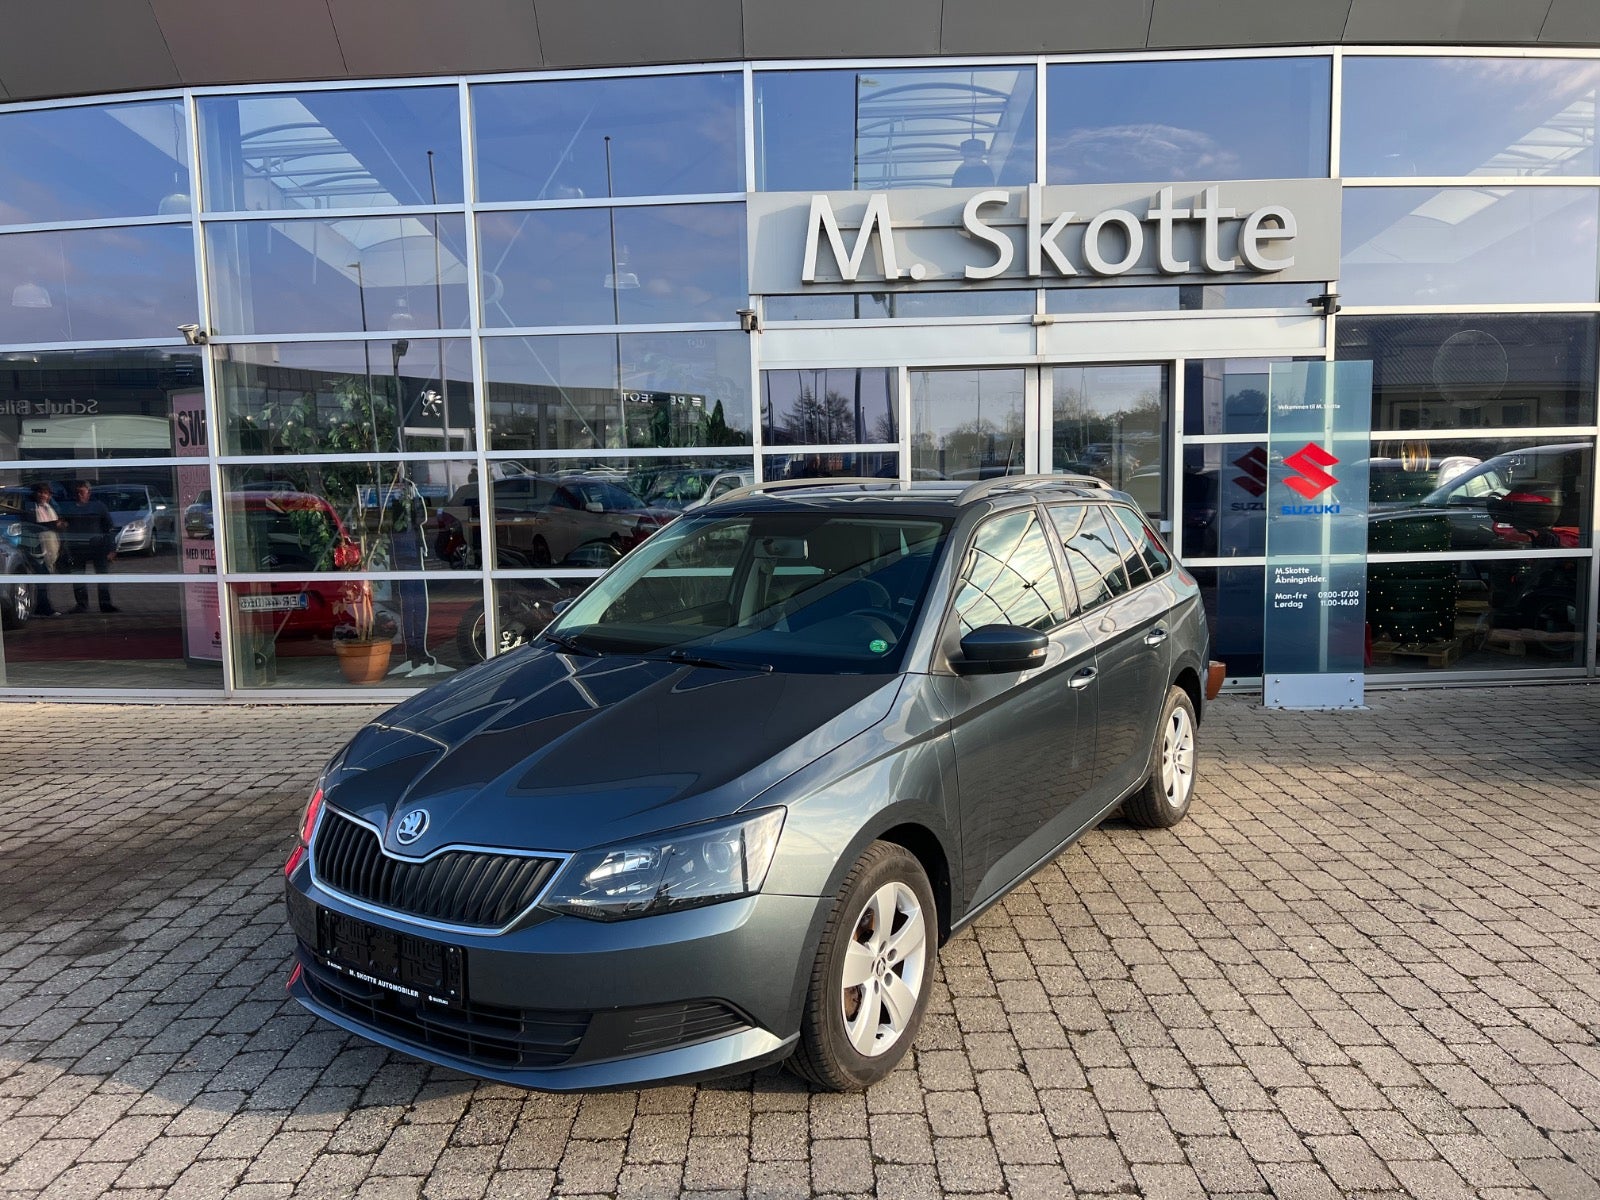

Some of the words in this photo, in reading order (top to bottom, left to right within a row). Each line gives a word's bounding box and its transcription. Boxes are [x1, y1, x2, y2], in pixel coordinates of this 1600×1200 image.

[802, 193, 927, 284] M.
[963, 181, 1298, 280] Skotte
[1281, 504, 1340, 515] SUZUKI
[349, 969, 355, 977] M.
[356, 972, 377, 984] SKOTTE
[378, 980, 419, 997] AUTOMOBILER
